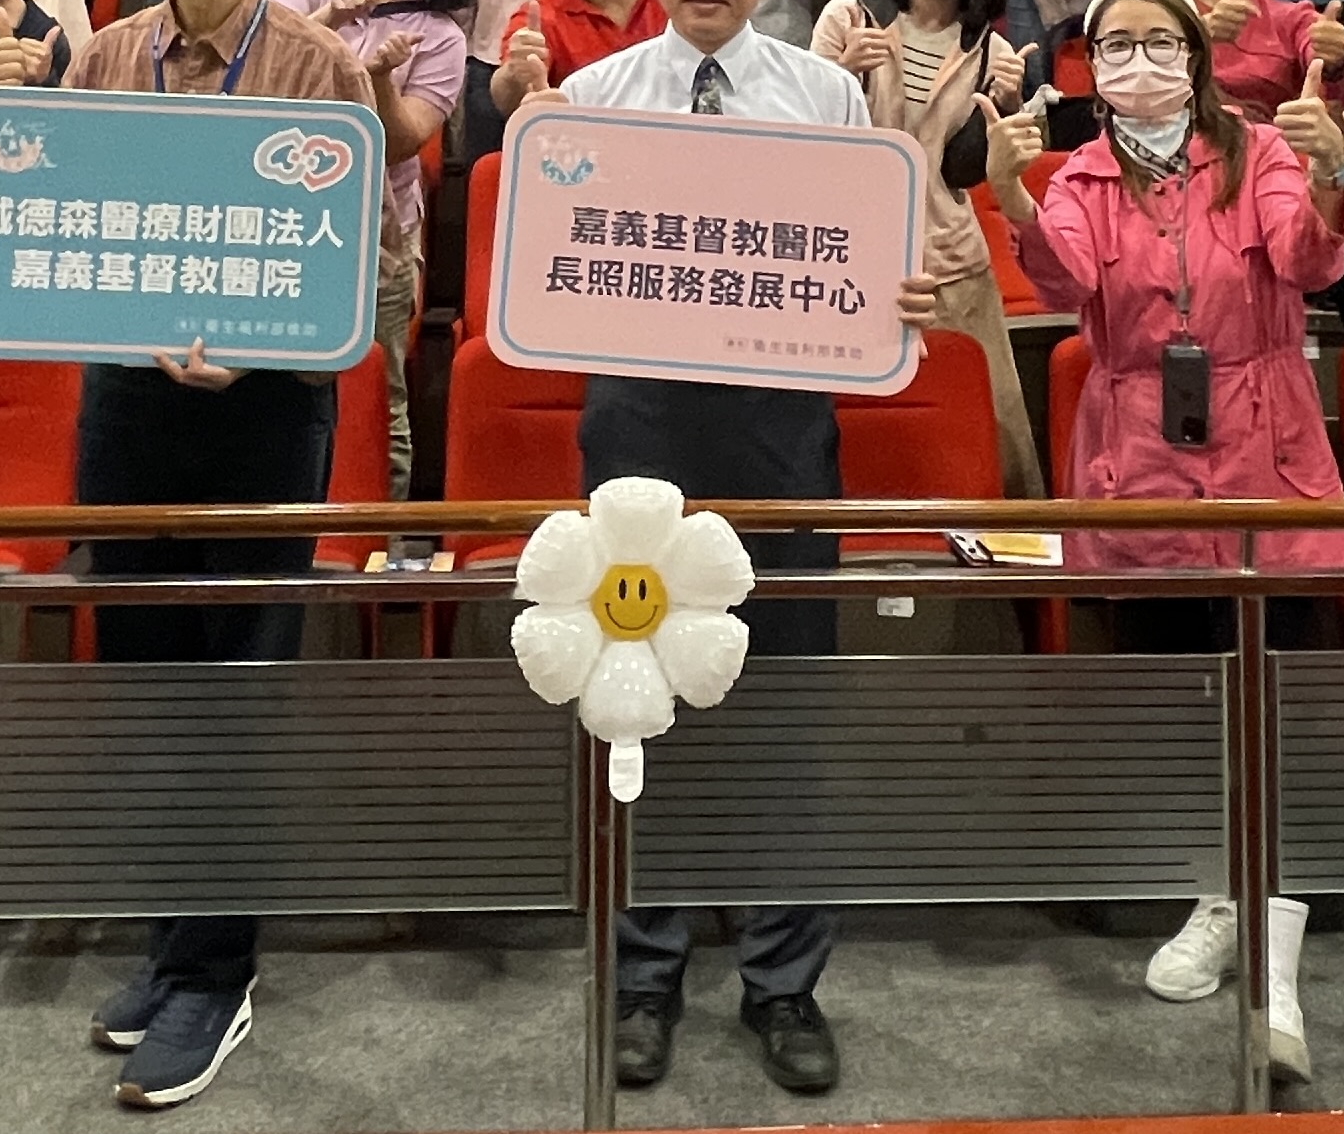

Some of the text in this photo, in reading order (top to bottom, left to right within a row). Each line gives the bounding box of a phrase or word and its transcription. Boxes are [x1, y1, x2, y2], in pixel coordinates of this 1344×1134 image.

[570, 206, 850, 264] 嘉義基督教醫院
[11, 249, 302, 299] 嘉義基督教醫院
[546, 256, 866, 315] 長照服務發展中心
